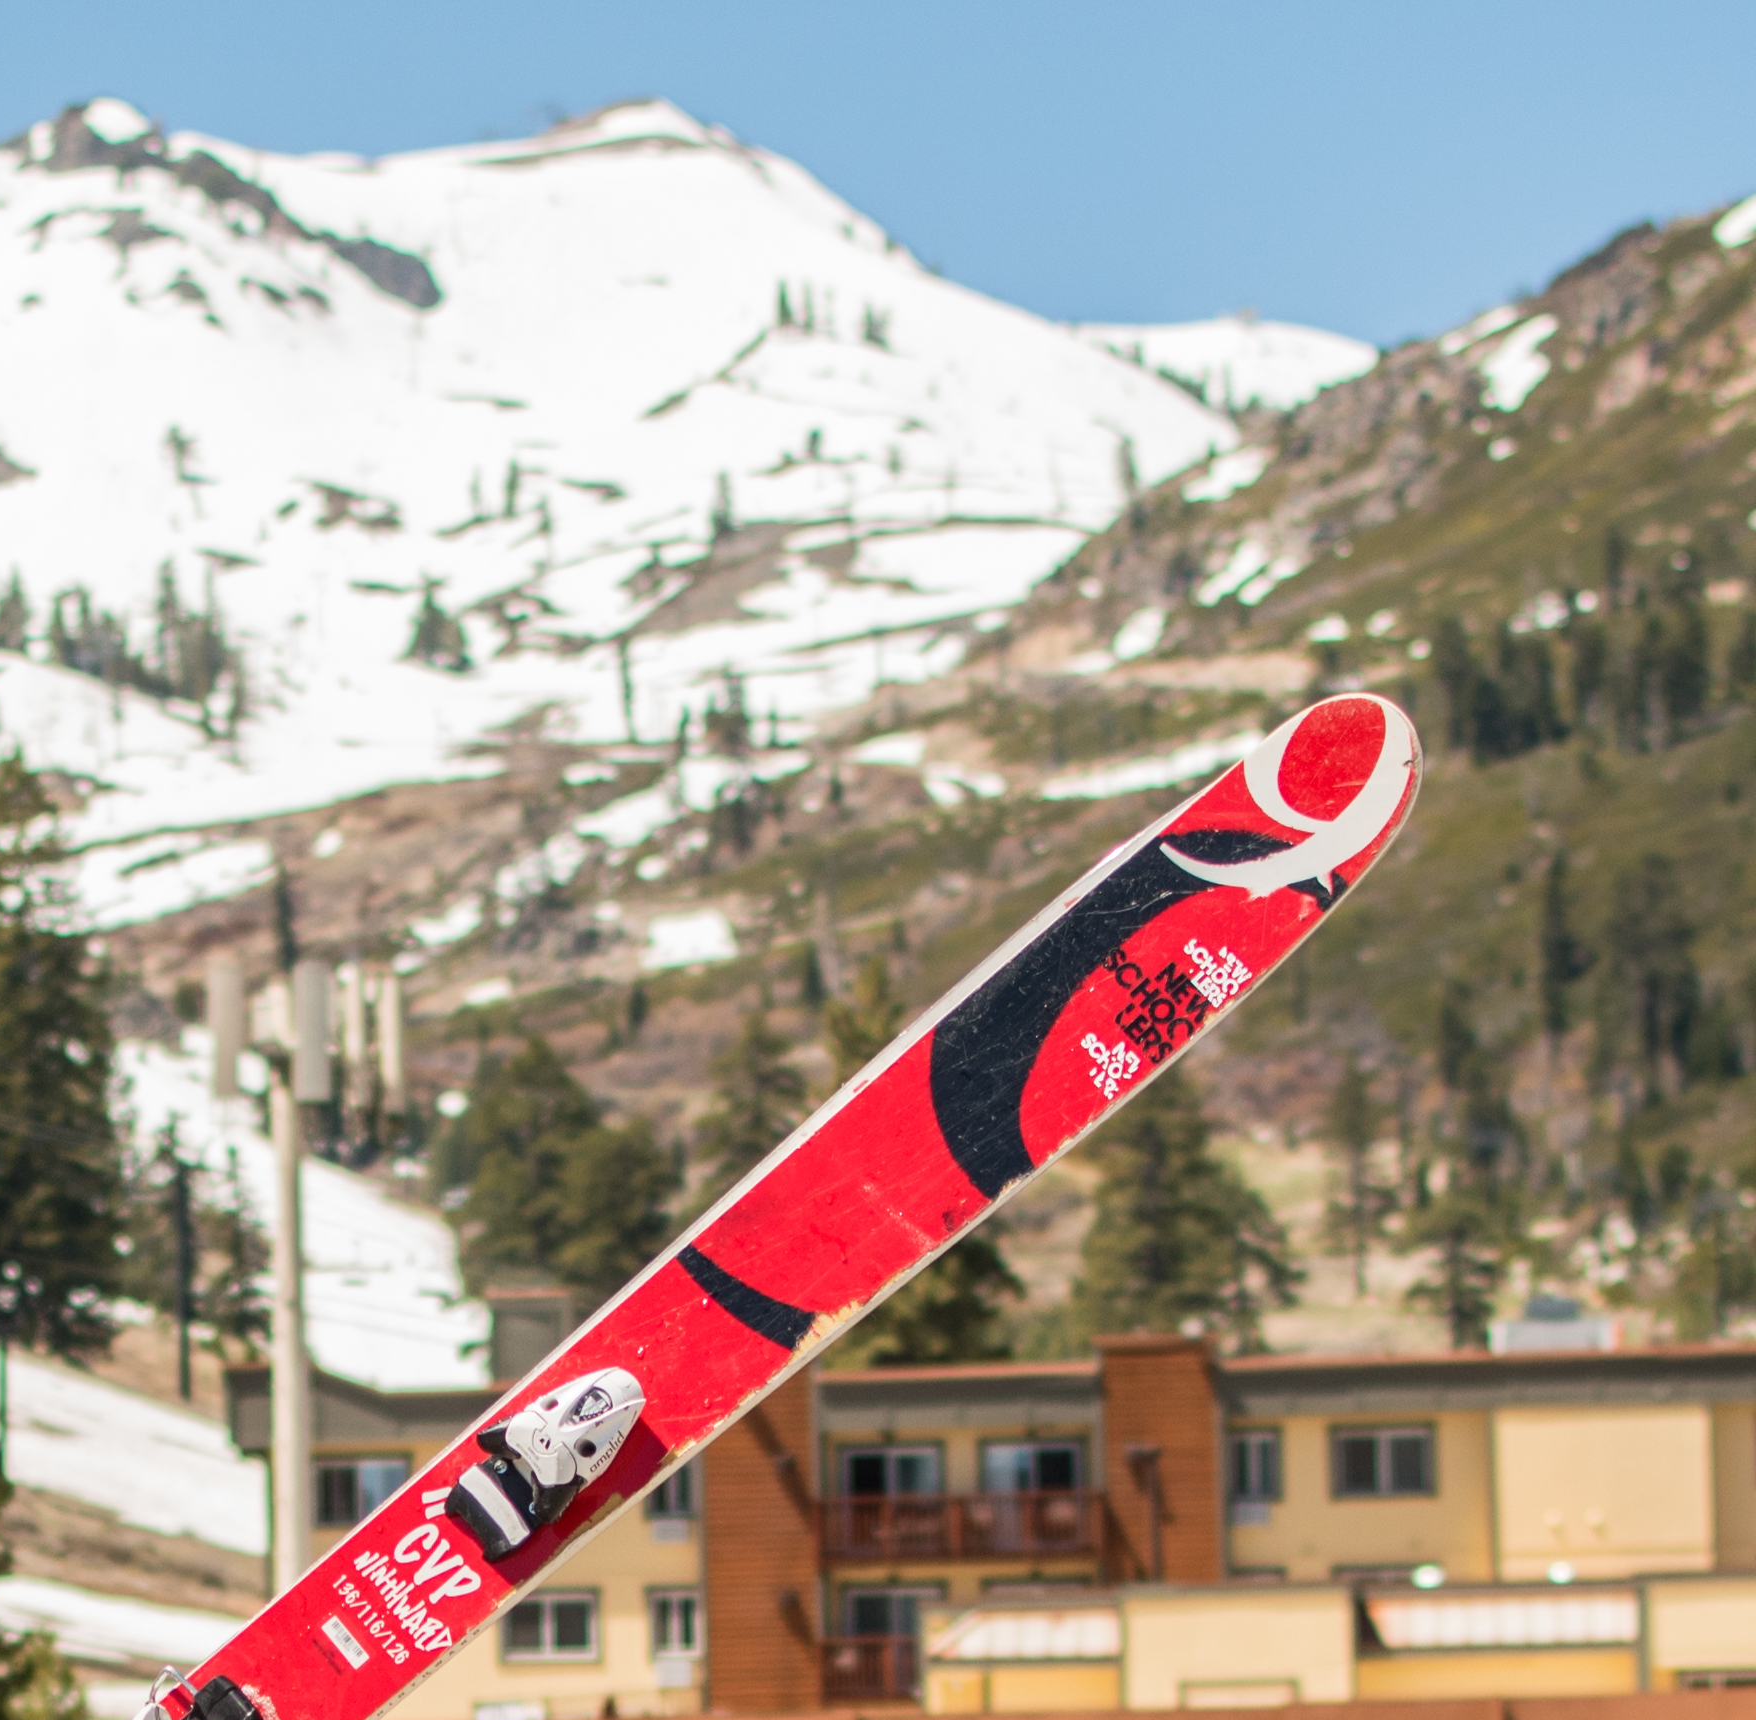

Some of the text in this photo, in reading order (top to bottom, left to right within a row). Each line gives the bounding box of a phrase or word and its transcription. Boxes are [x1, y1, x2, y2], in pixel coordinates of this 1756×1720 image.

[1154, 962, 1211, 1024] NEW
[589, 1429, 625, 1473] amplid
[394, 1523, 481, 1604] CVP
[332, 1574, 410, 1665] 136/116/126
